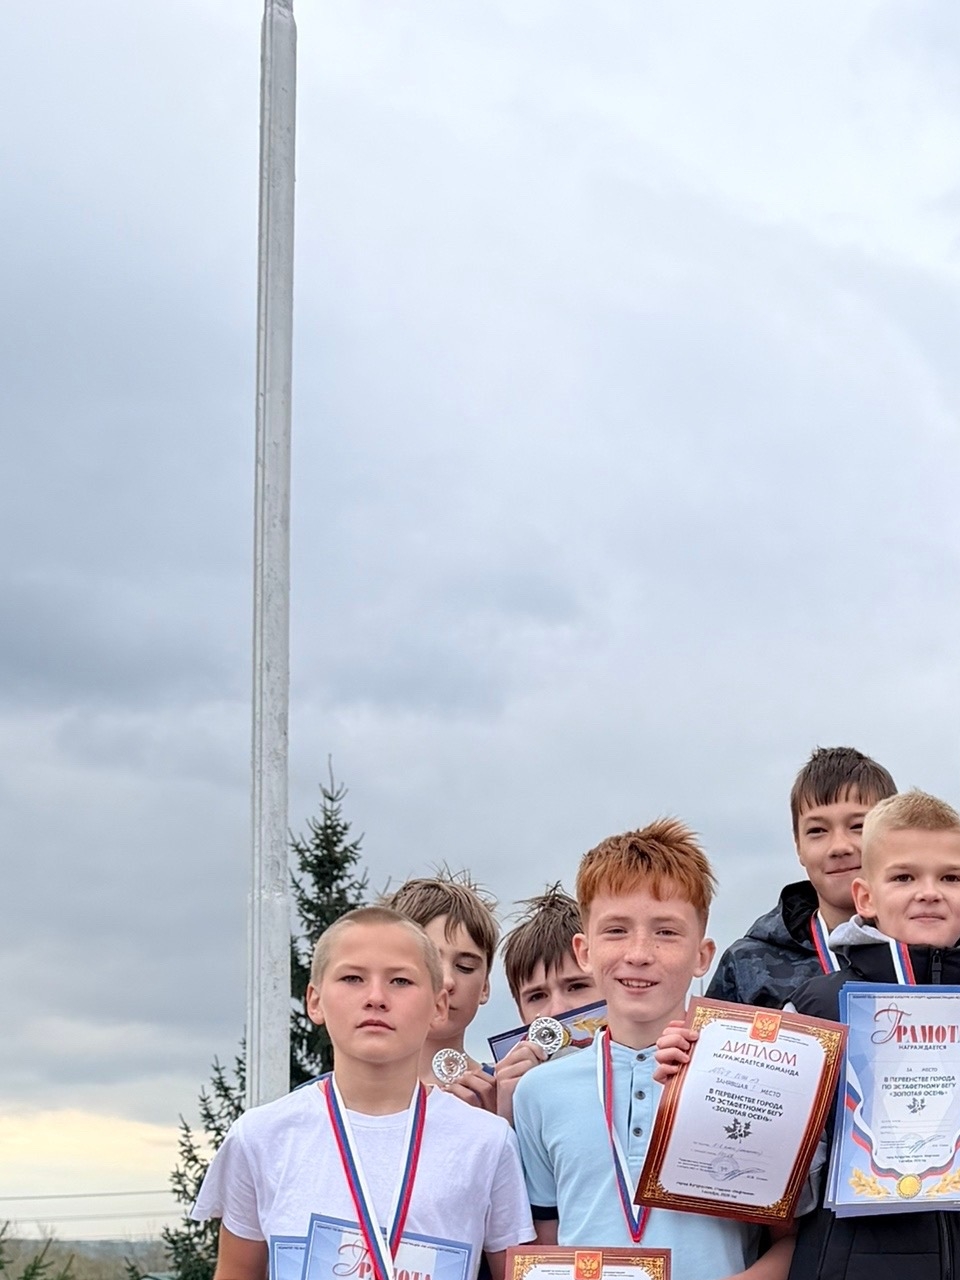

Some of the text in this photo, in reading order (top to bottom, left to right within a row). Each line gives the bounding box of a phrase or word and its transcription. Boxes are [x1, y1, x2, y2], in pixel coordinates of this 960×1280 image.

[713, 1052, 765, 1068] НАГРАЖДАЕТСЯ
[765, 1064, 799, 1077] КОМАНДА
[721, 1040, 797, 1067] ДИПЛОМ
[715, 1089, 755, 1104] ПЕРВЕНСТВЕ
[756, 1099, 783, 1110] ГОРОДА
[760, 1089, 781, 1098] МЕСТО
[705, 1095, 783, 1117] ПО ЭСТАФЕТНОМУ БЕГУ
